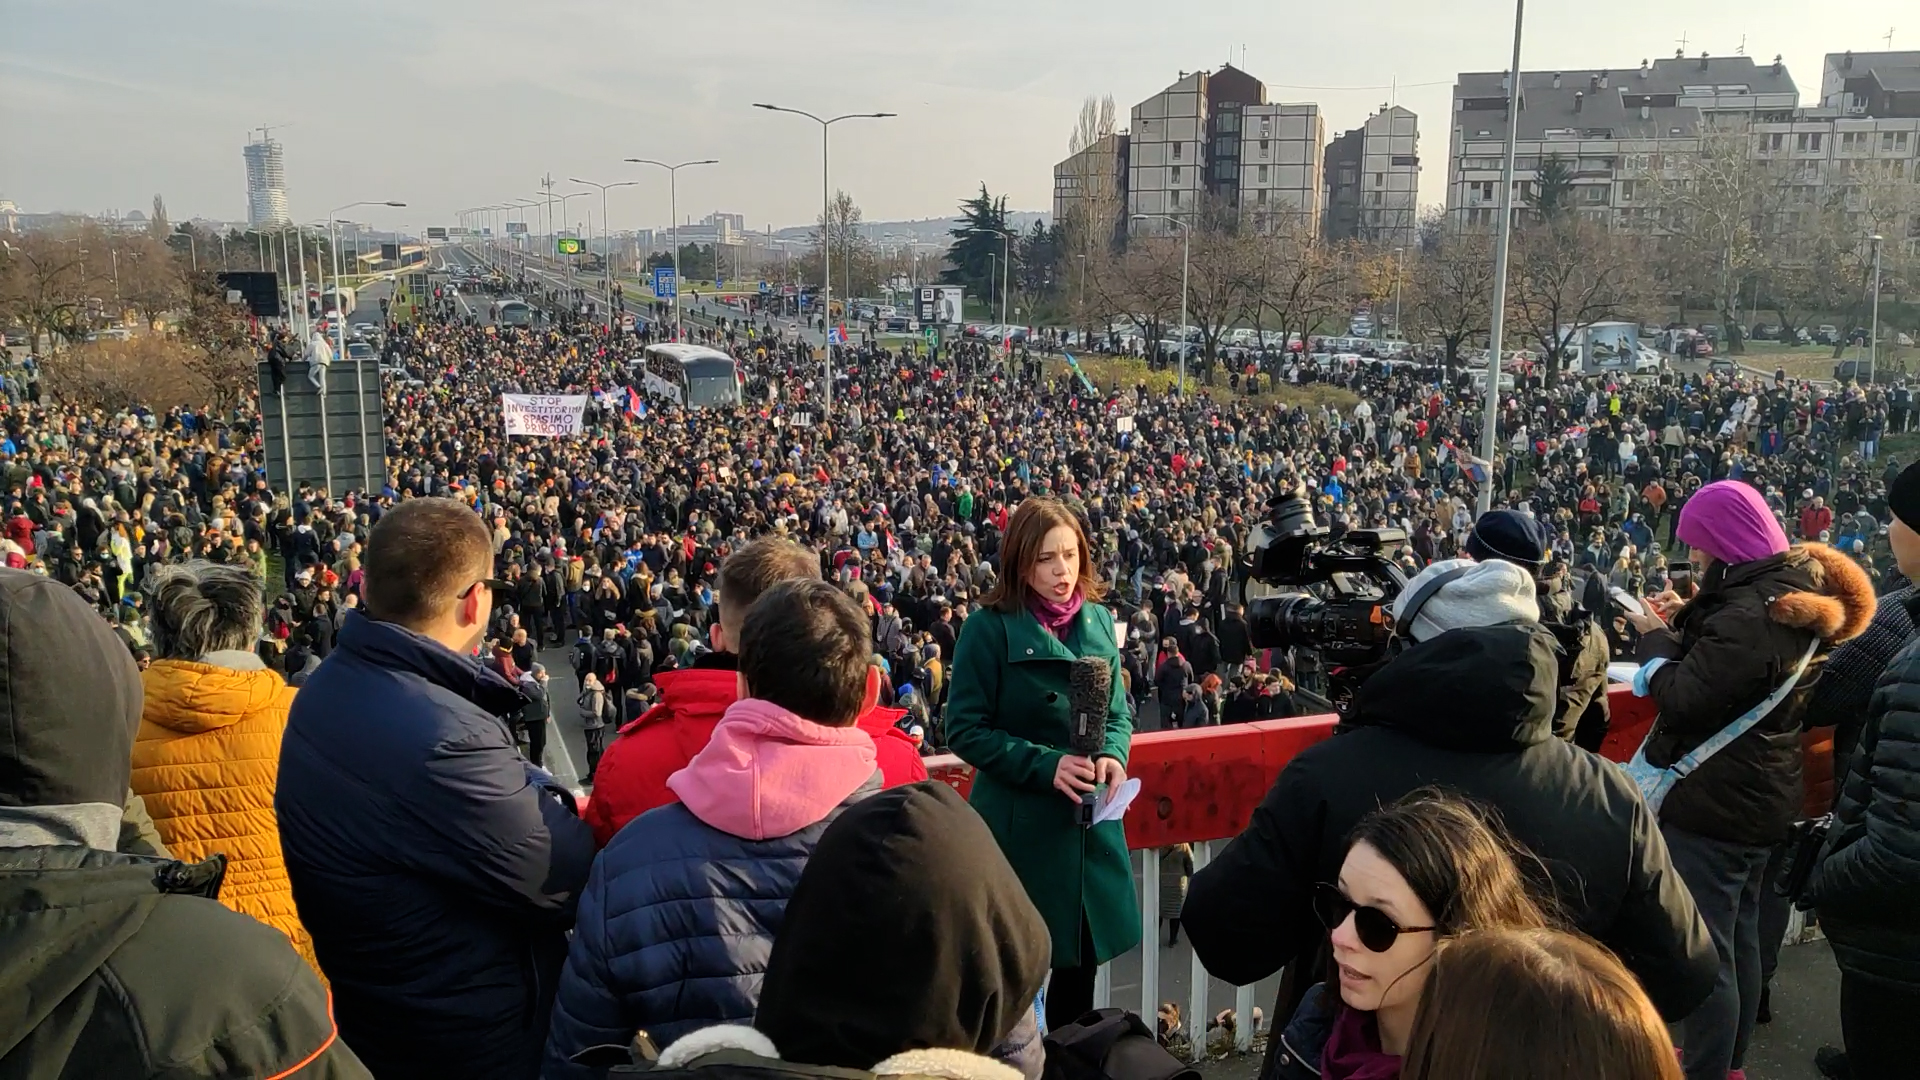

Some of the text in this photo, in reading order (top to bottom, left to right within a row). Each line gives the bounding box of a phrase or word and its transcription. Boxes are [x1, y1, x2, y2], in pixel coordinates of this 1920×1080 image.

[530, 396, 561, 405] STOP
[507, 404, 582, 414] INVESTITORIMA
[523, 414, 573, 424] SPASIMO
[525, 424, 573, 433] PRIRODU
